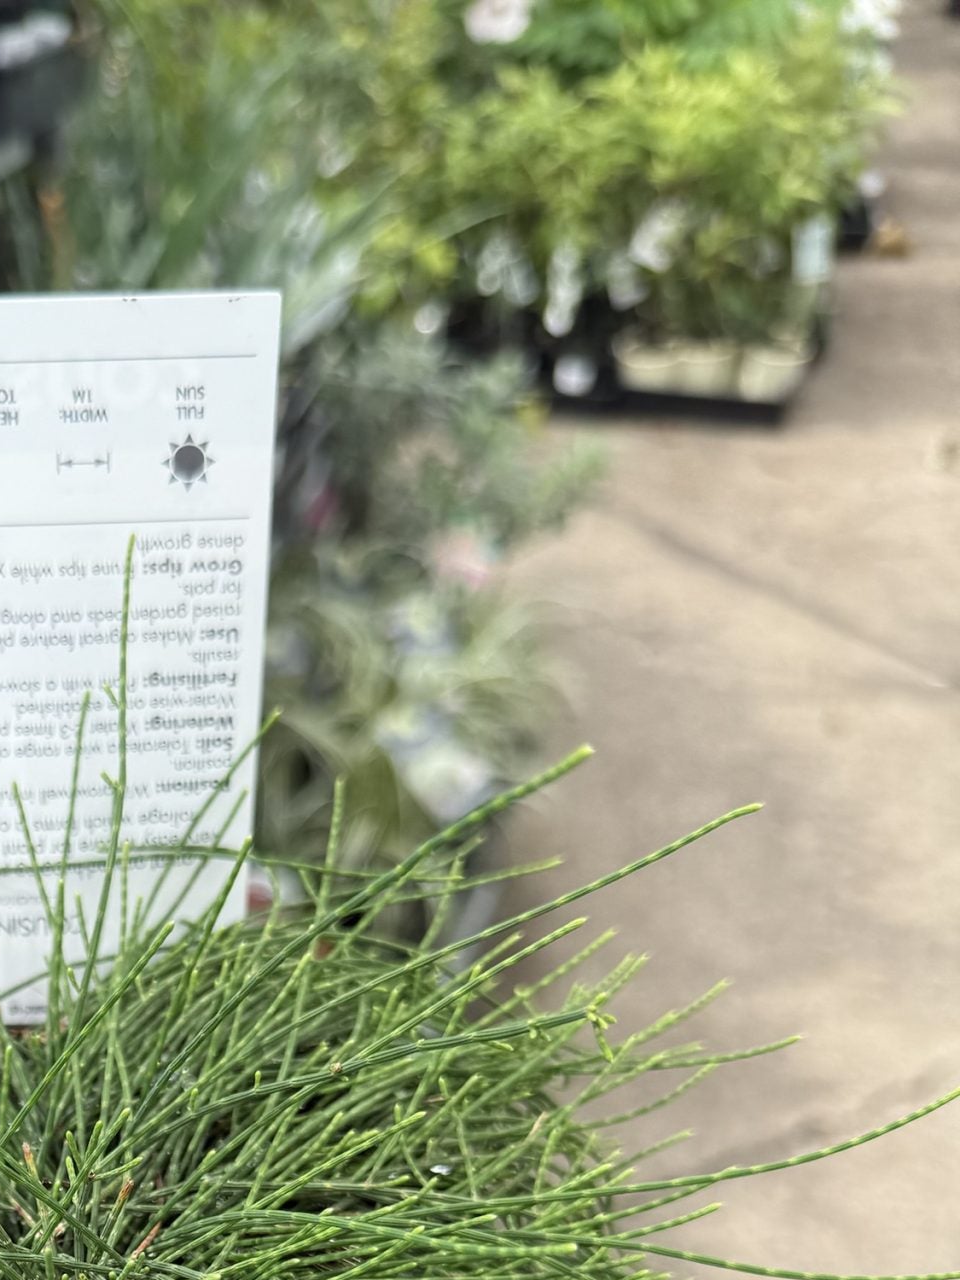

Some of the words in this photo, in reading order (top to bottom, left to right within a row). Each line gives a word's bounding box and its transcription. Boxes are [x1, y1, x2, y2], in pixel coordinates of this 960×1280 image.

[71, 388, 93, 404] 1M
[174, 385, 206, 401] SUN
[58, 407, 109, 424] WIDTH:
[175, 405, 205, 420] FULL
[197, 536, 245, 555] dense
[10, 565, 54, 586] while
[59, 560, 87, 582] tips
[143, 557, 183, 580] tips:
[189, 558, 243, 577] Grow
[178, 579, 216, 598] pots.
[219, 580, 242, 601] for
[0, 609, 46, 633] along
[49, 611, 82, 632] and
[129, 603, 188, 627] garden
[191, 605, 241, 625] raised
[19, 632, 76, 653] feature
[78, 628, 119, 649] great
[141, 629, 193, 649] Makes
[199, 628, 240, 646] Use:
[188, 649, 239, 670] results.
[62, 680, 93, 698] with
[98, 675, 137, 696] Pant
[142, 671, 238, 694] Fertilising:
[14, 699, 103, 720] esablished.
[106, 698, 146, 713] one
[149, 692, 236, 712] Water-wise
[14, 724, 55, 741] times
[146, 715, 234, 735] Watering:
[14, 742, 60, 759] range
[62, 743, 102, 757] wie
[197, 737, 233, 756] Soil:
[171, 755, 231, 772] position.
[84, 816, 131, 832] wich
